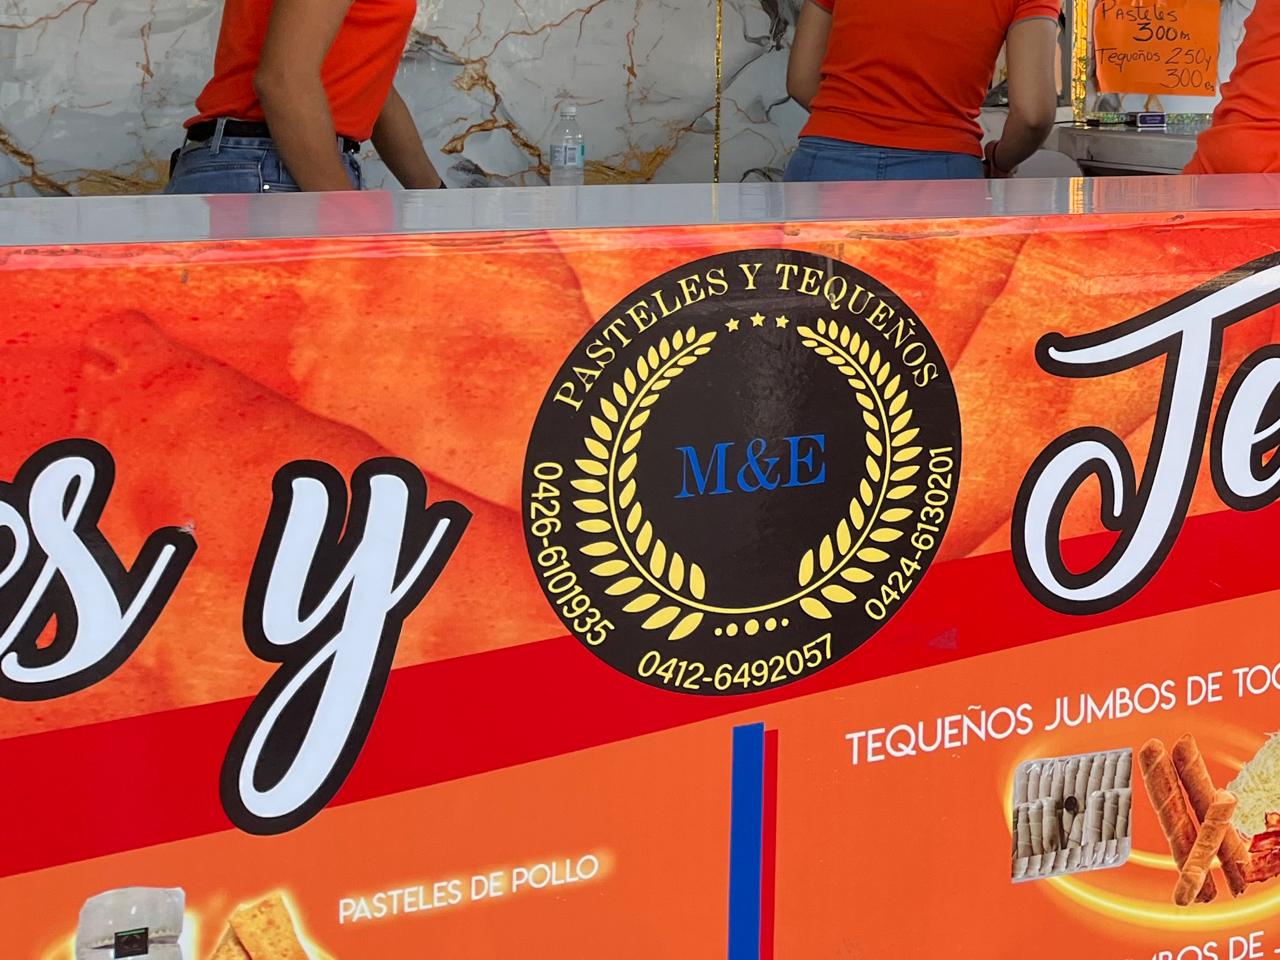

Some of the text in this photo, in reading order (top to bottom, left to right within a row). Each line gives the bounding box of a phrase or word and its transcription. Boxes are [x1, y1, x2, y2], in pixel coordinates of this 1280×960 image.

[1095, 48, 1161, 72] Tequeños
[1165, 47, 1206, 64] 250
[1133, 22, 1178, 41] 300
[1160, 68, 1203, 88] 300
[554, 263, 939, 412] PASTELES Y TEQUEÑOS
[674, 433, 827, 500] M&E
[530, 461, 616, 646] 0426-6101935
[864, 445, 954, 622] 0424-6130201
[232, 467, 458, 824] y
[638, 632, 833, 691] 0412-6492057
[845, 703, 1034, 766] TEQUEÑOS
[1045, 679, 1177, 732] JUMBOS
[1186, 671, 1224, 706] DE
[339, 854, 600, 925] PASTELES DE POLLO
[1229, 930, 1265, 960] DE
